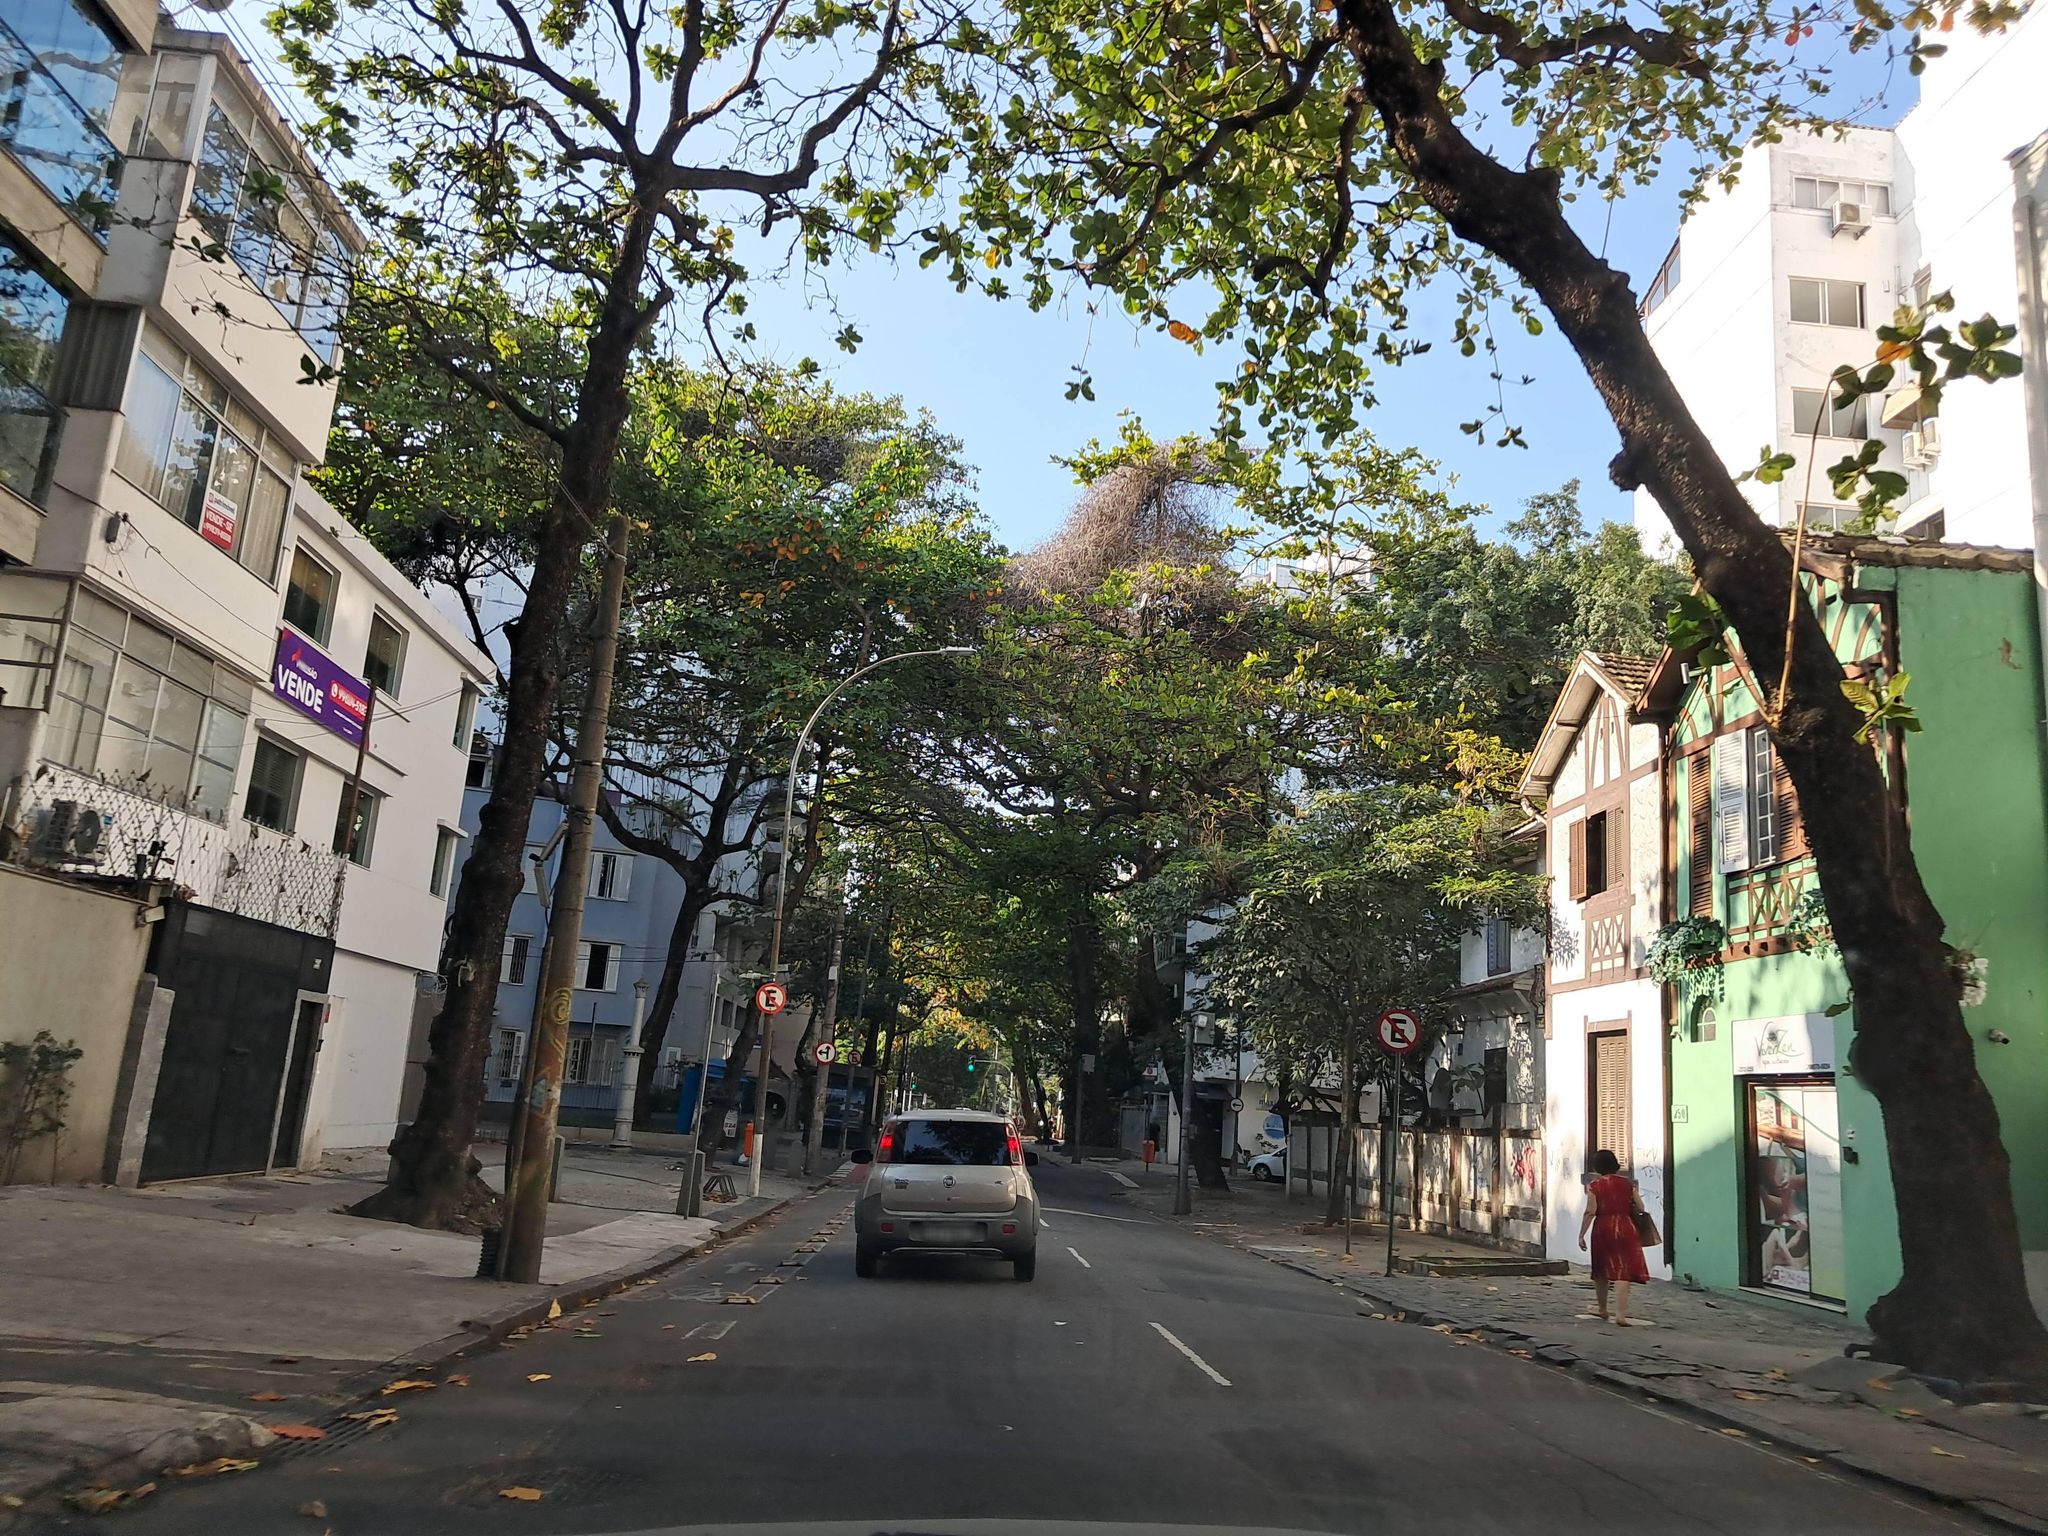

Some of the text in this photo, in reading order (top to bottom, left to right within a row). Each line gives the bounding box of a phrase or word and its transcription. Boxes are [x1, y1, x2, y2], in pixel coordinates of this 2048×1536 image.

[206, 510, 234, 533] VENDE-SE
[278, 664, 324, 714] VENDE
[765, 988, 778, 1007] E
[1390, 1018, 1407, 1043] E
